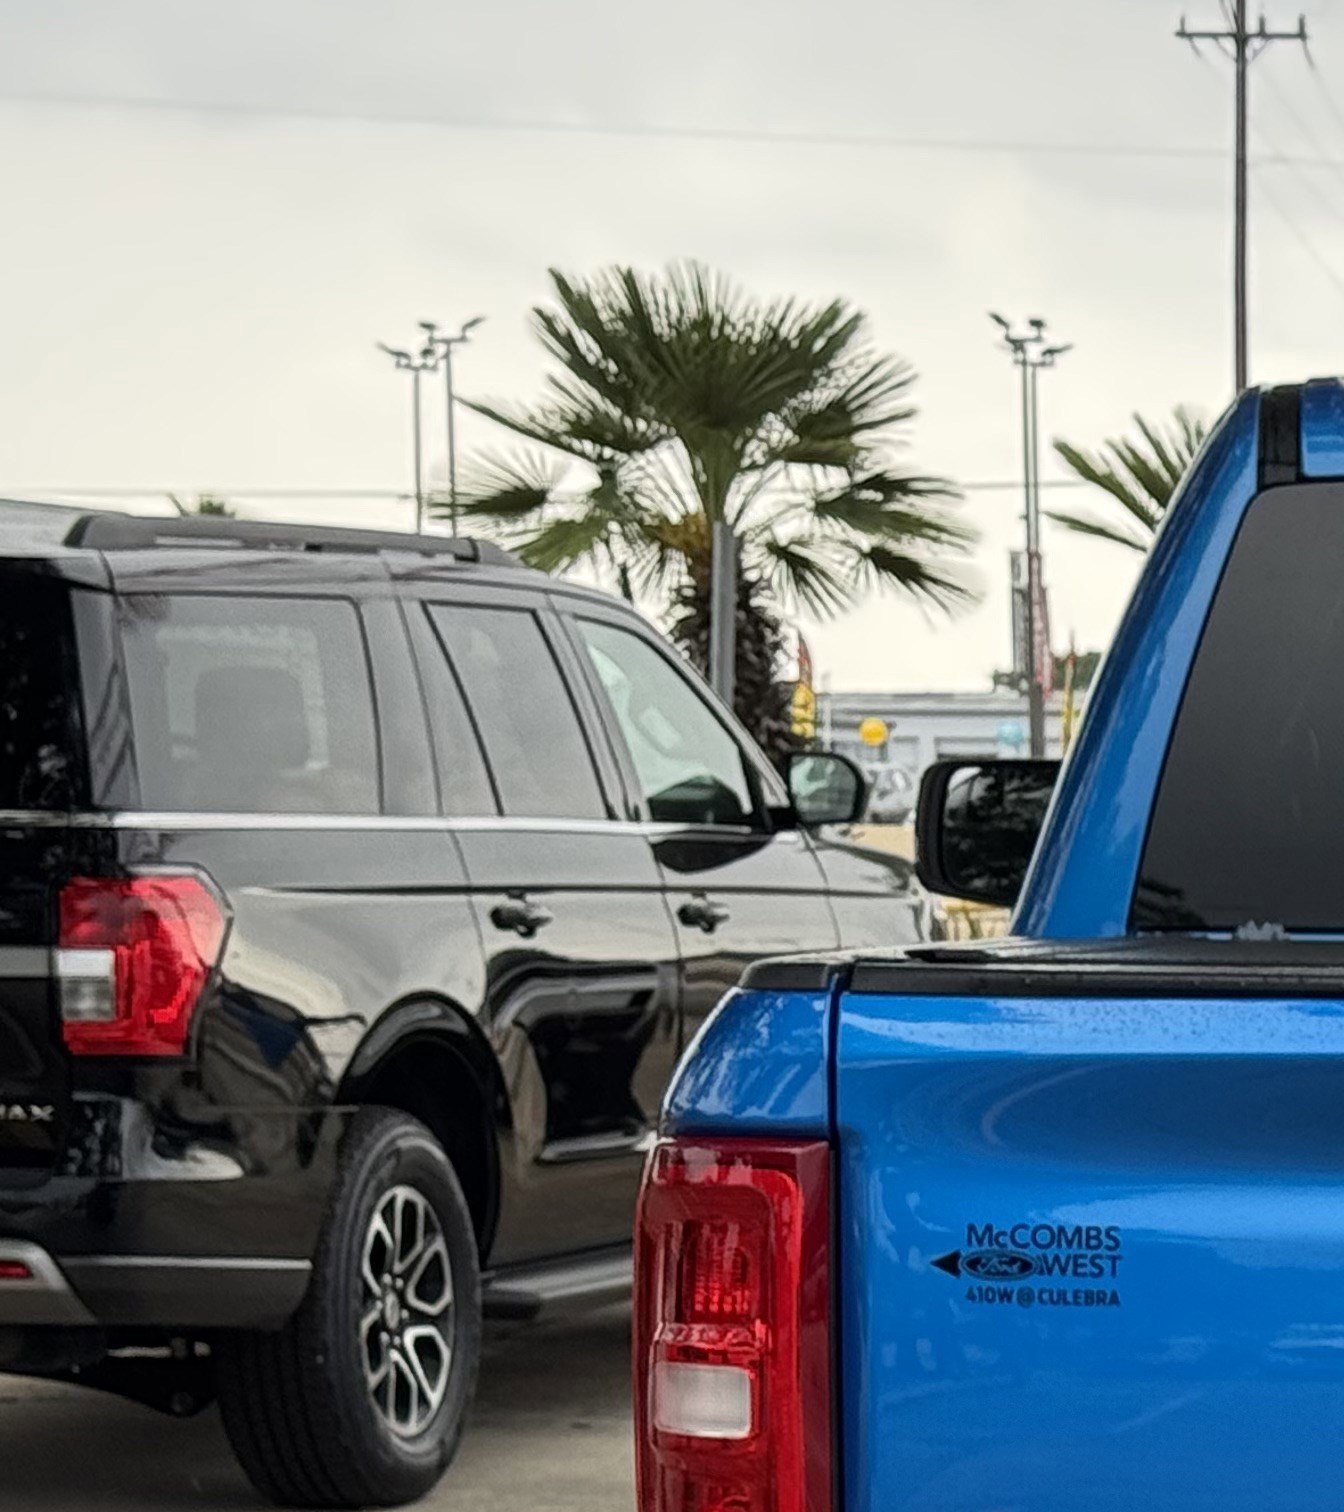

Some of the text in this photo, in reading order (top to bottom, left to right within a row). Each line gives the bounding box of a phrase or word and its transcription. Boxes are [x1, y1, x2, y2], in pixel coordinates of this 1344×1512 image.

[0, 1103, 55, 1122] AX
[965, 1222, 1121, 1252] McCOMBS
[1037, 1252, 1123, 1279] WEST
